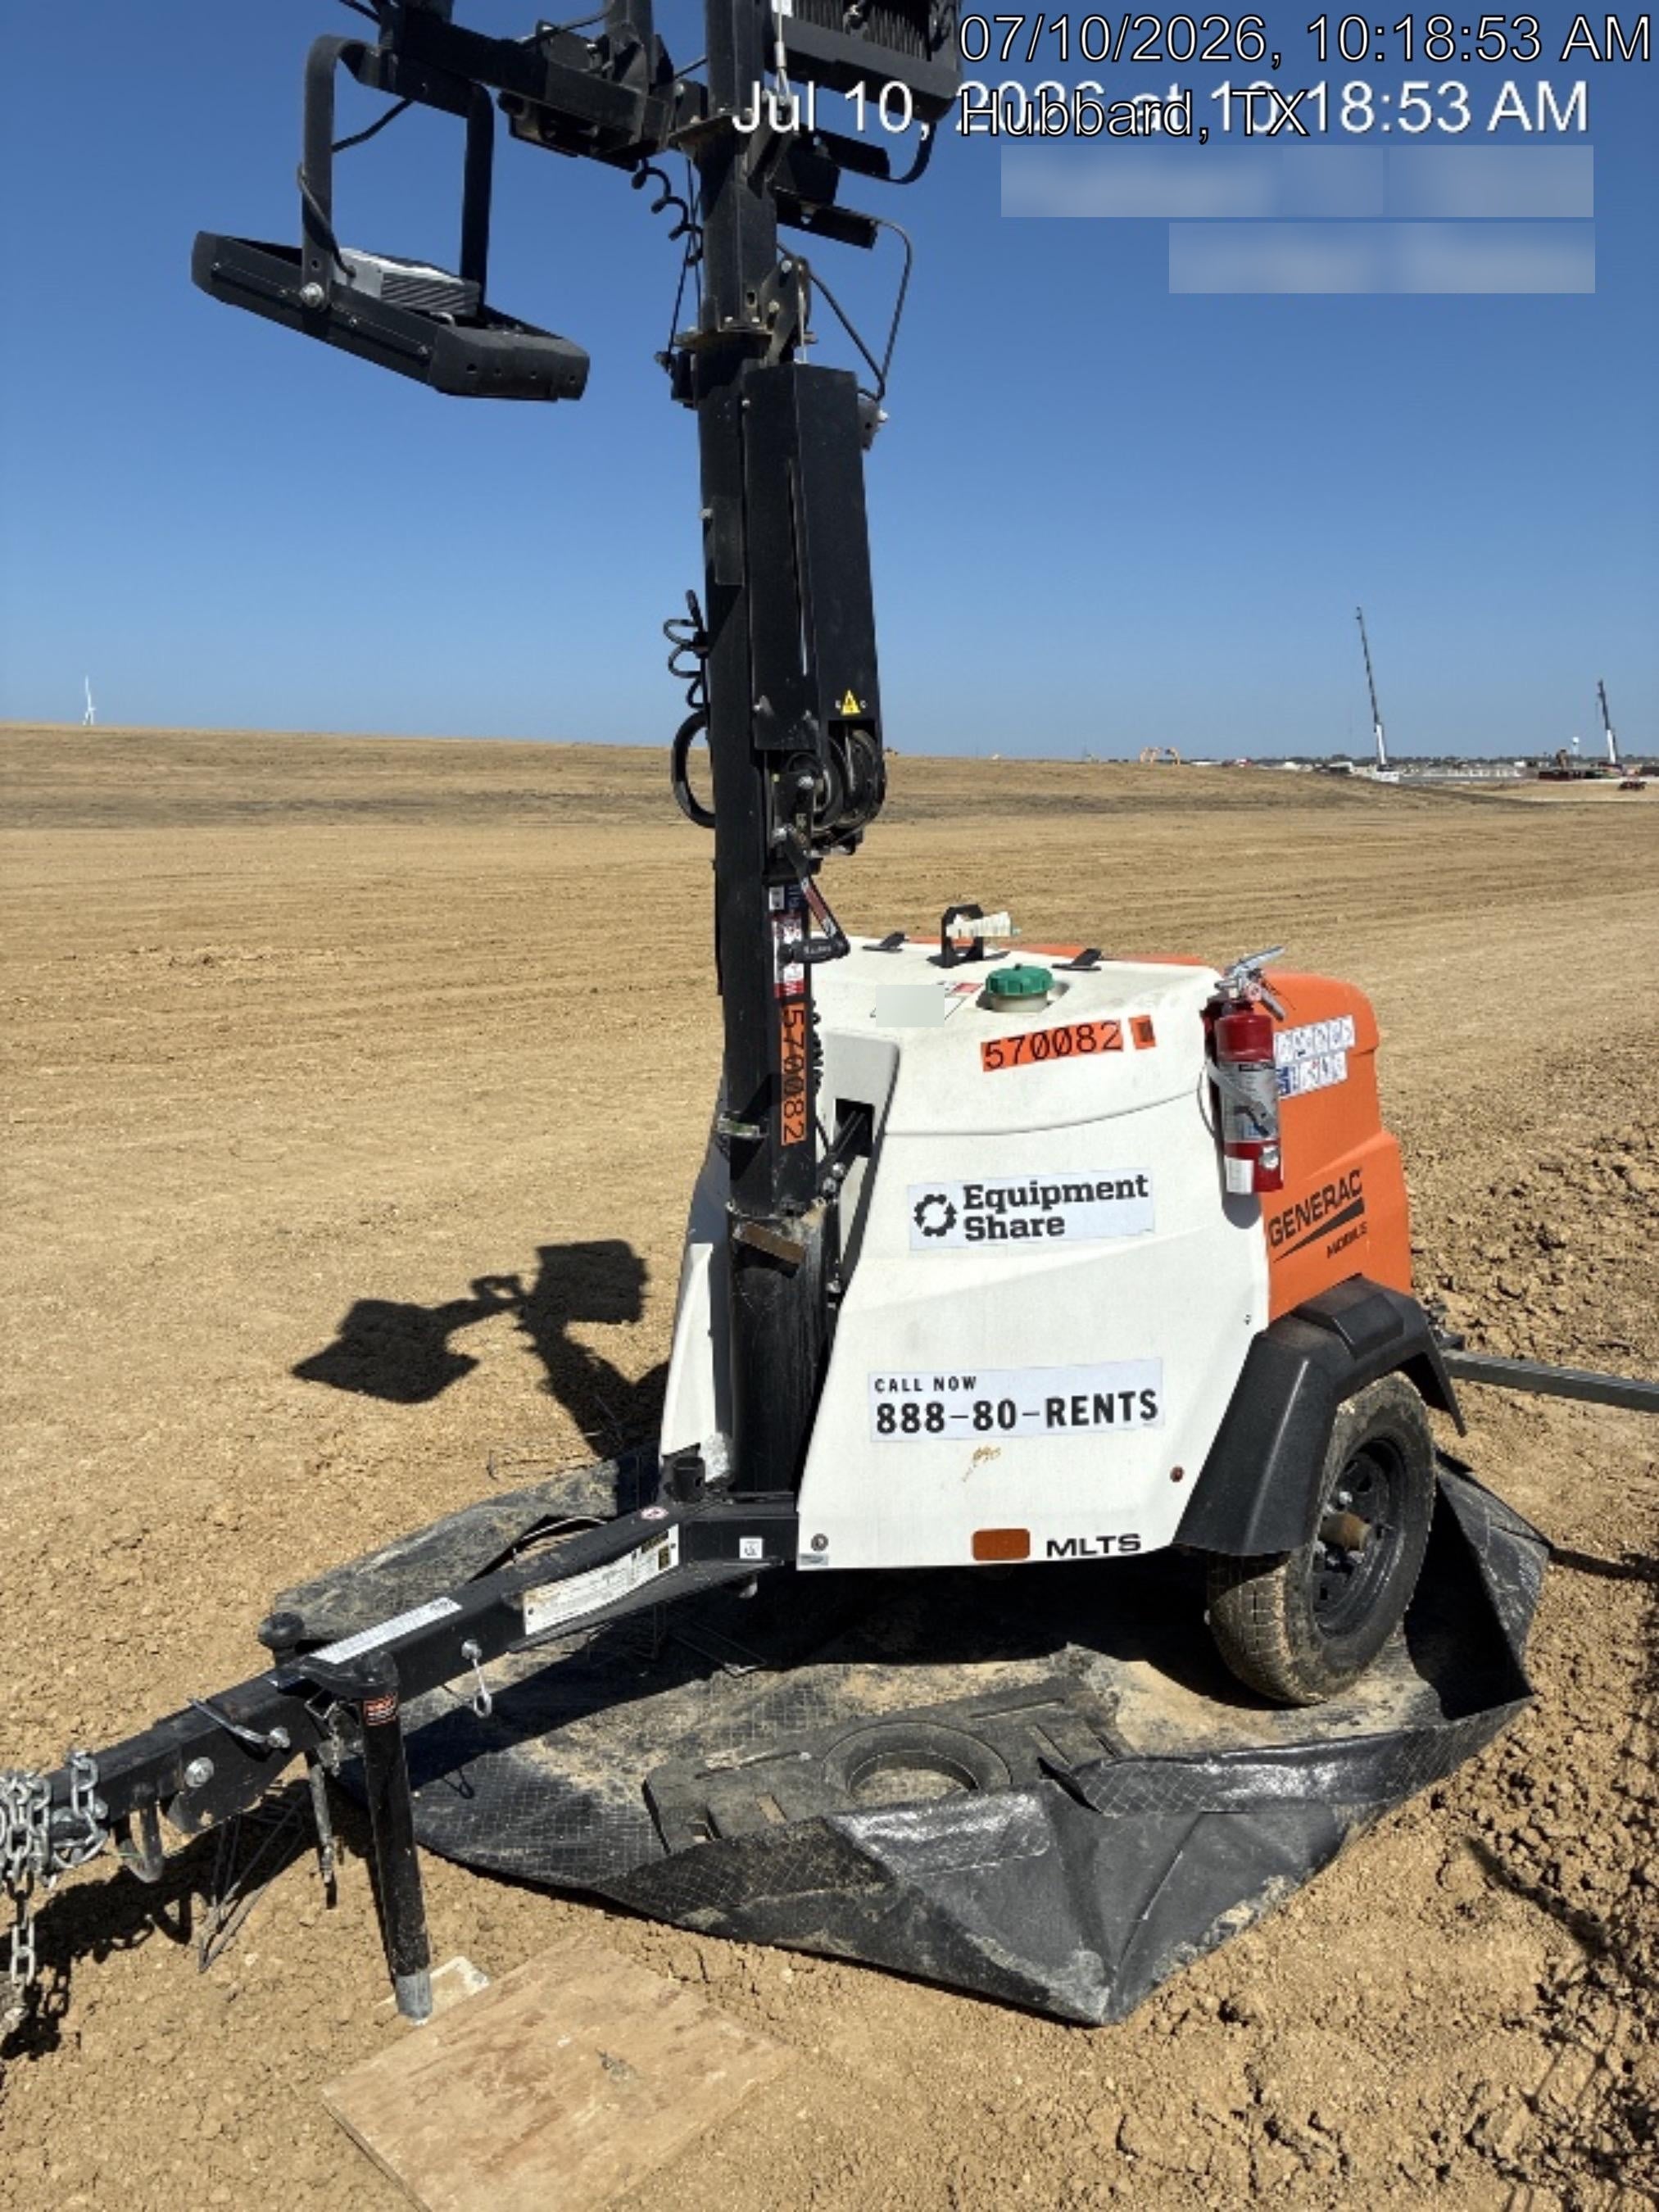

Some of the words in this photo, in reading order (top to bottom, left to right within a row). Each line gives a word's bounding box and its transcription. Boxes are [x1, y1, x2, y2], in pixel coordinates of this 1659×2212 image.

[984, 1021, 1123, 1070] 570082
[783, 1008, 805, 1142] 570082
[963, 1174, 1149, 1214] Equipment
[1268, 1168, 1363, 1249] GENERAC
[963, 1214, 1066, 1241] Share
[874, 1377, 923, 1393] CALL
[933, 1376, 977, 1392] NOW
[876, 1389, 1159, 1435] 888-80-RENTS
[1046, 1533, 1142, 1557] MLTS
